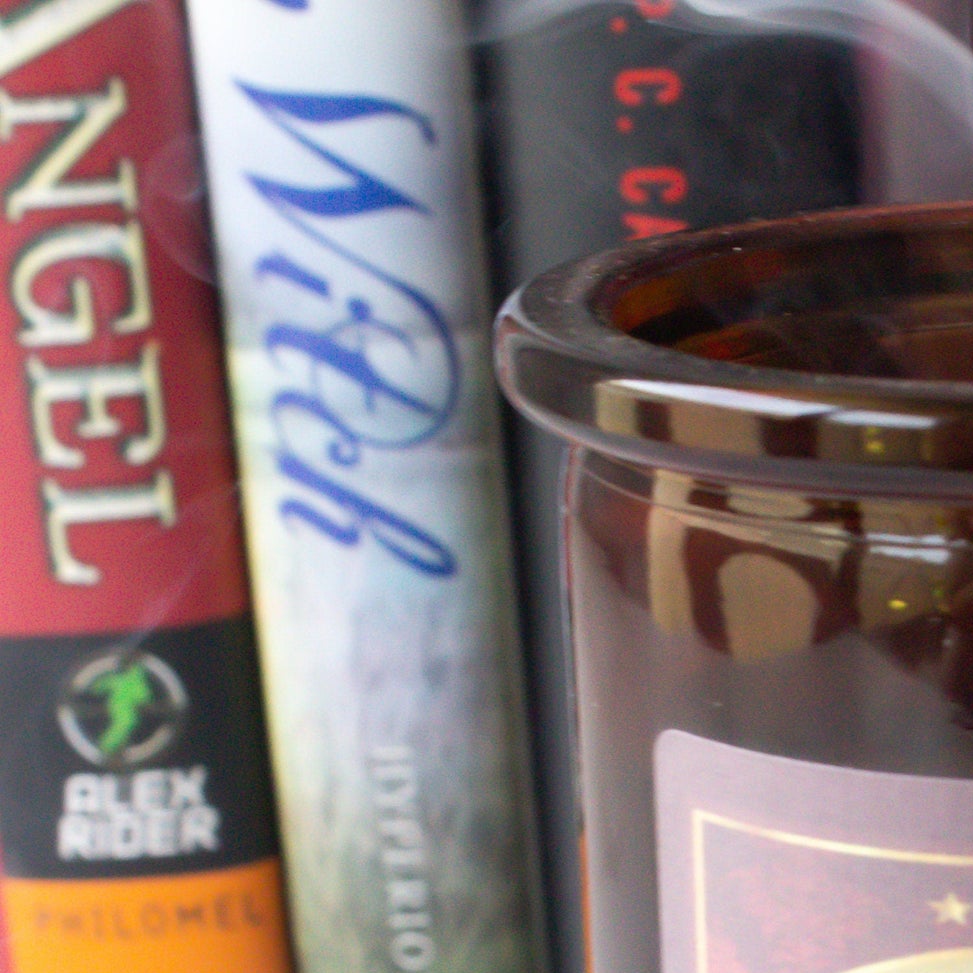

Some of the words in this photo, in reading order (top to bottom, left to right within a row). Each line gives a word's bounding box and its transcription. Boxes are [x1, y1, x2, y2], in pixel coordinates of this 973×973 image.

[228, 78, 458, 578] Witch
[63, 764, 207, 814] ALEX
[57, 803, 221, 862] RIDER
